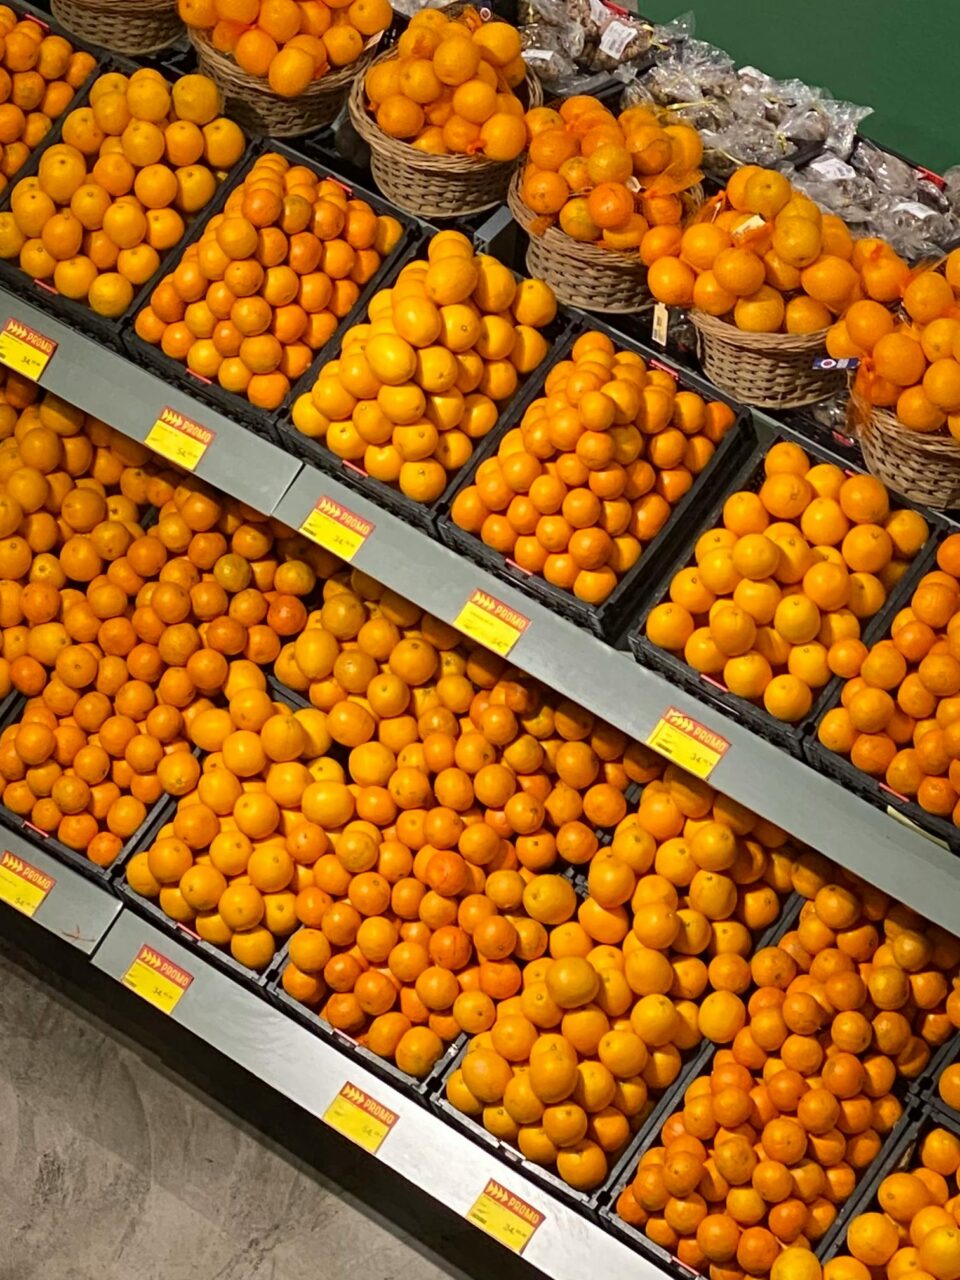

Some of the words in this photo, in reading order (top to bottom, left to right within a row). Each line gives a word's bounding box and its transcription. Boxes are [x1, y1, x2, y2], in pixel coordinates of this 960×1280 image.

[27, 332, 53, 353] PROMO
[182, 420, 211, 443] PROMO
[340, 511, 370, 533] PROMO
[494, 605, 525, 628] PROMO
[693, 726, 727, 751] PROMO
[22, 867, 51, 889] PROMO
[161, 963, 189, 986] PROMO
[363, 1099, 395, 1124] PROMO
[508, 1197, 540, 1223] PROMO
